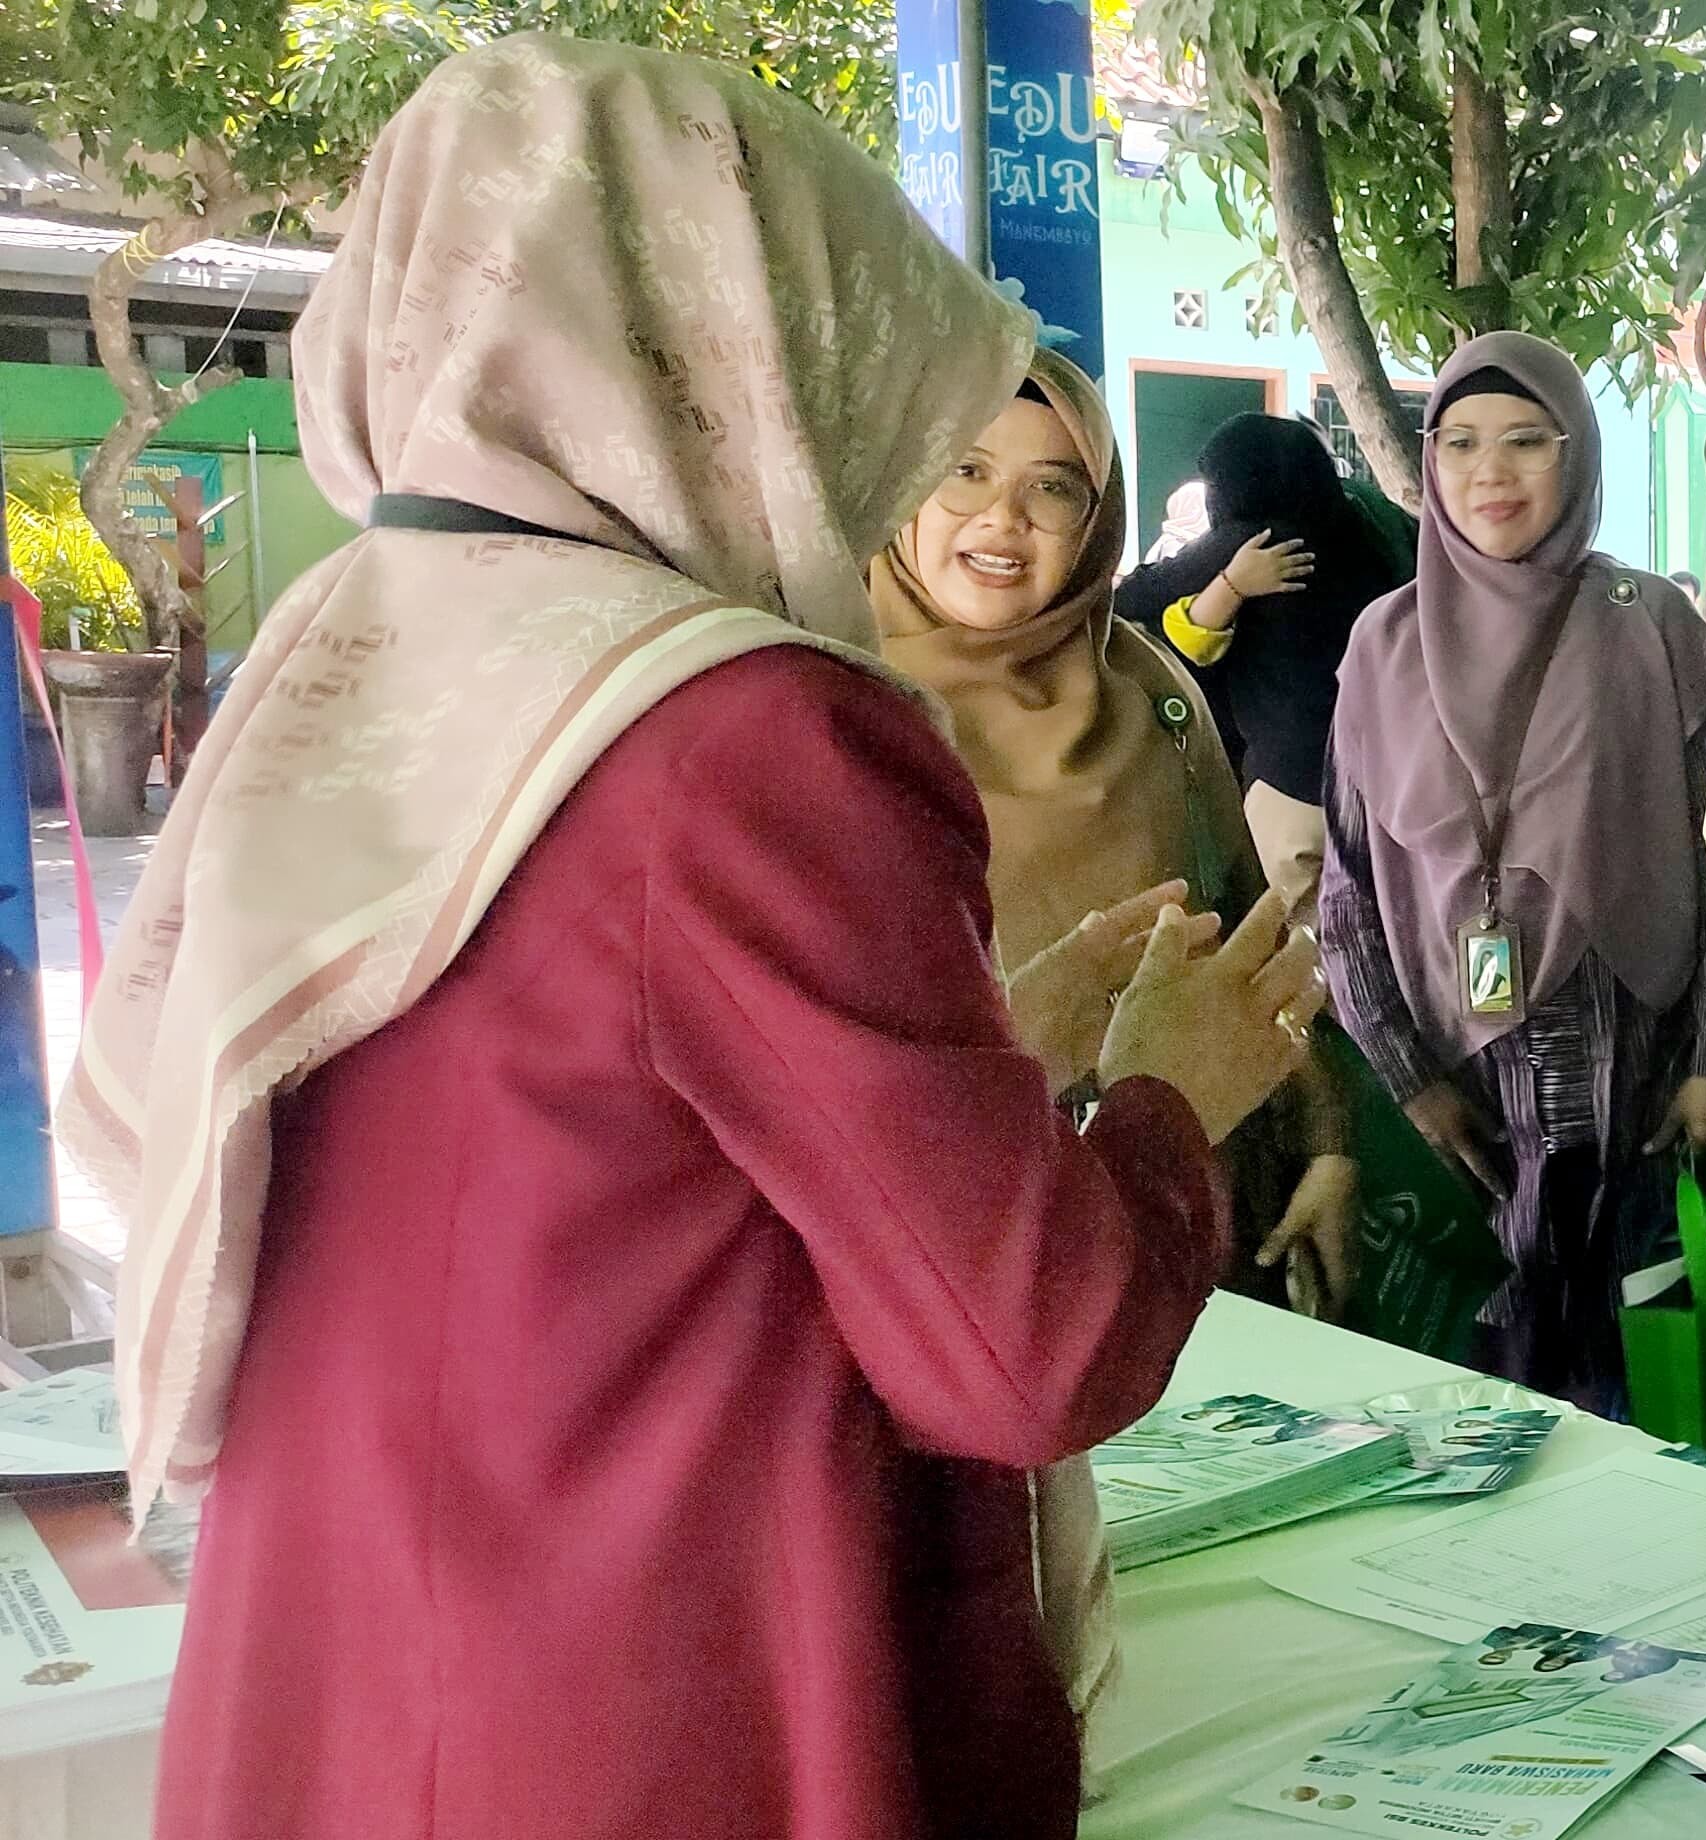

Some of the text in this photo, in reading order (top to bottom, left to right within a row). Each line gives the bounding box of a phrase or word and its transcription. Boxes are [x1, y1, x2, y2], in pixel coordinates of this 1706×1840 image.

[902, 61, 960, 144] EDU
[987, 64, 1096, 144] EDU
[902, 151, 963, 209] FAIR
[987, 148, 1099, 219] FAIR
[1456, 1762, 1507, 1777] BARU
[1507, 1763, 1617, 1778] MAHASISWA
